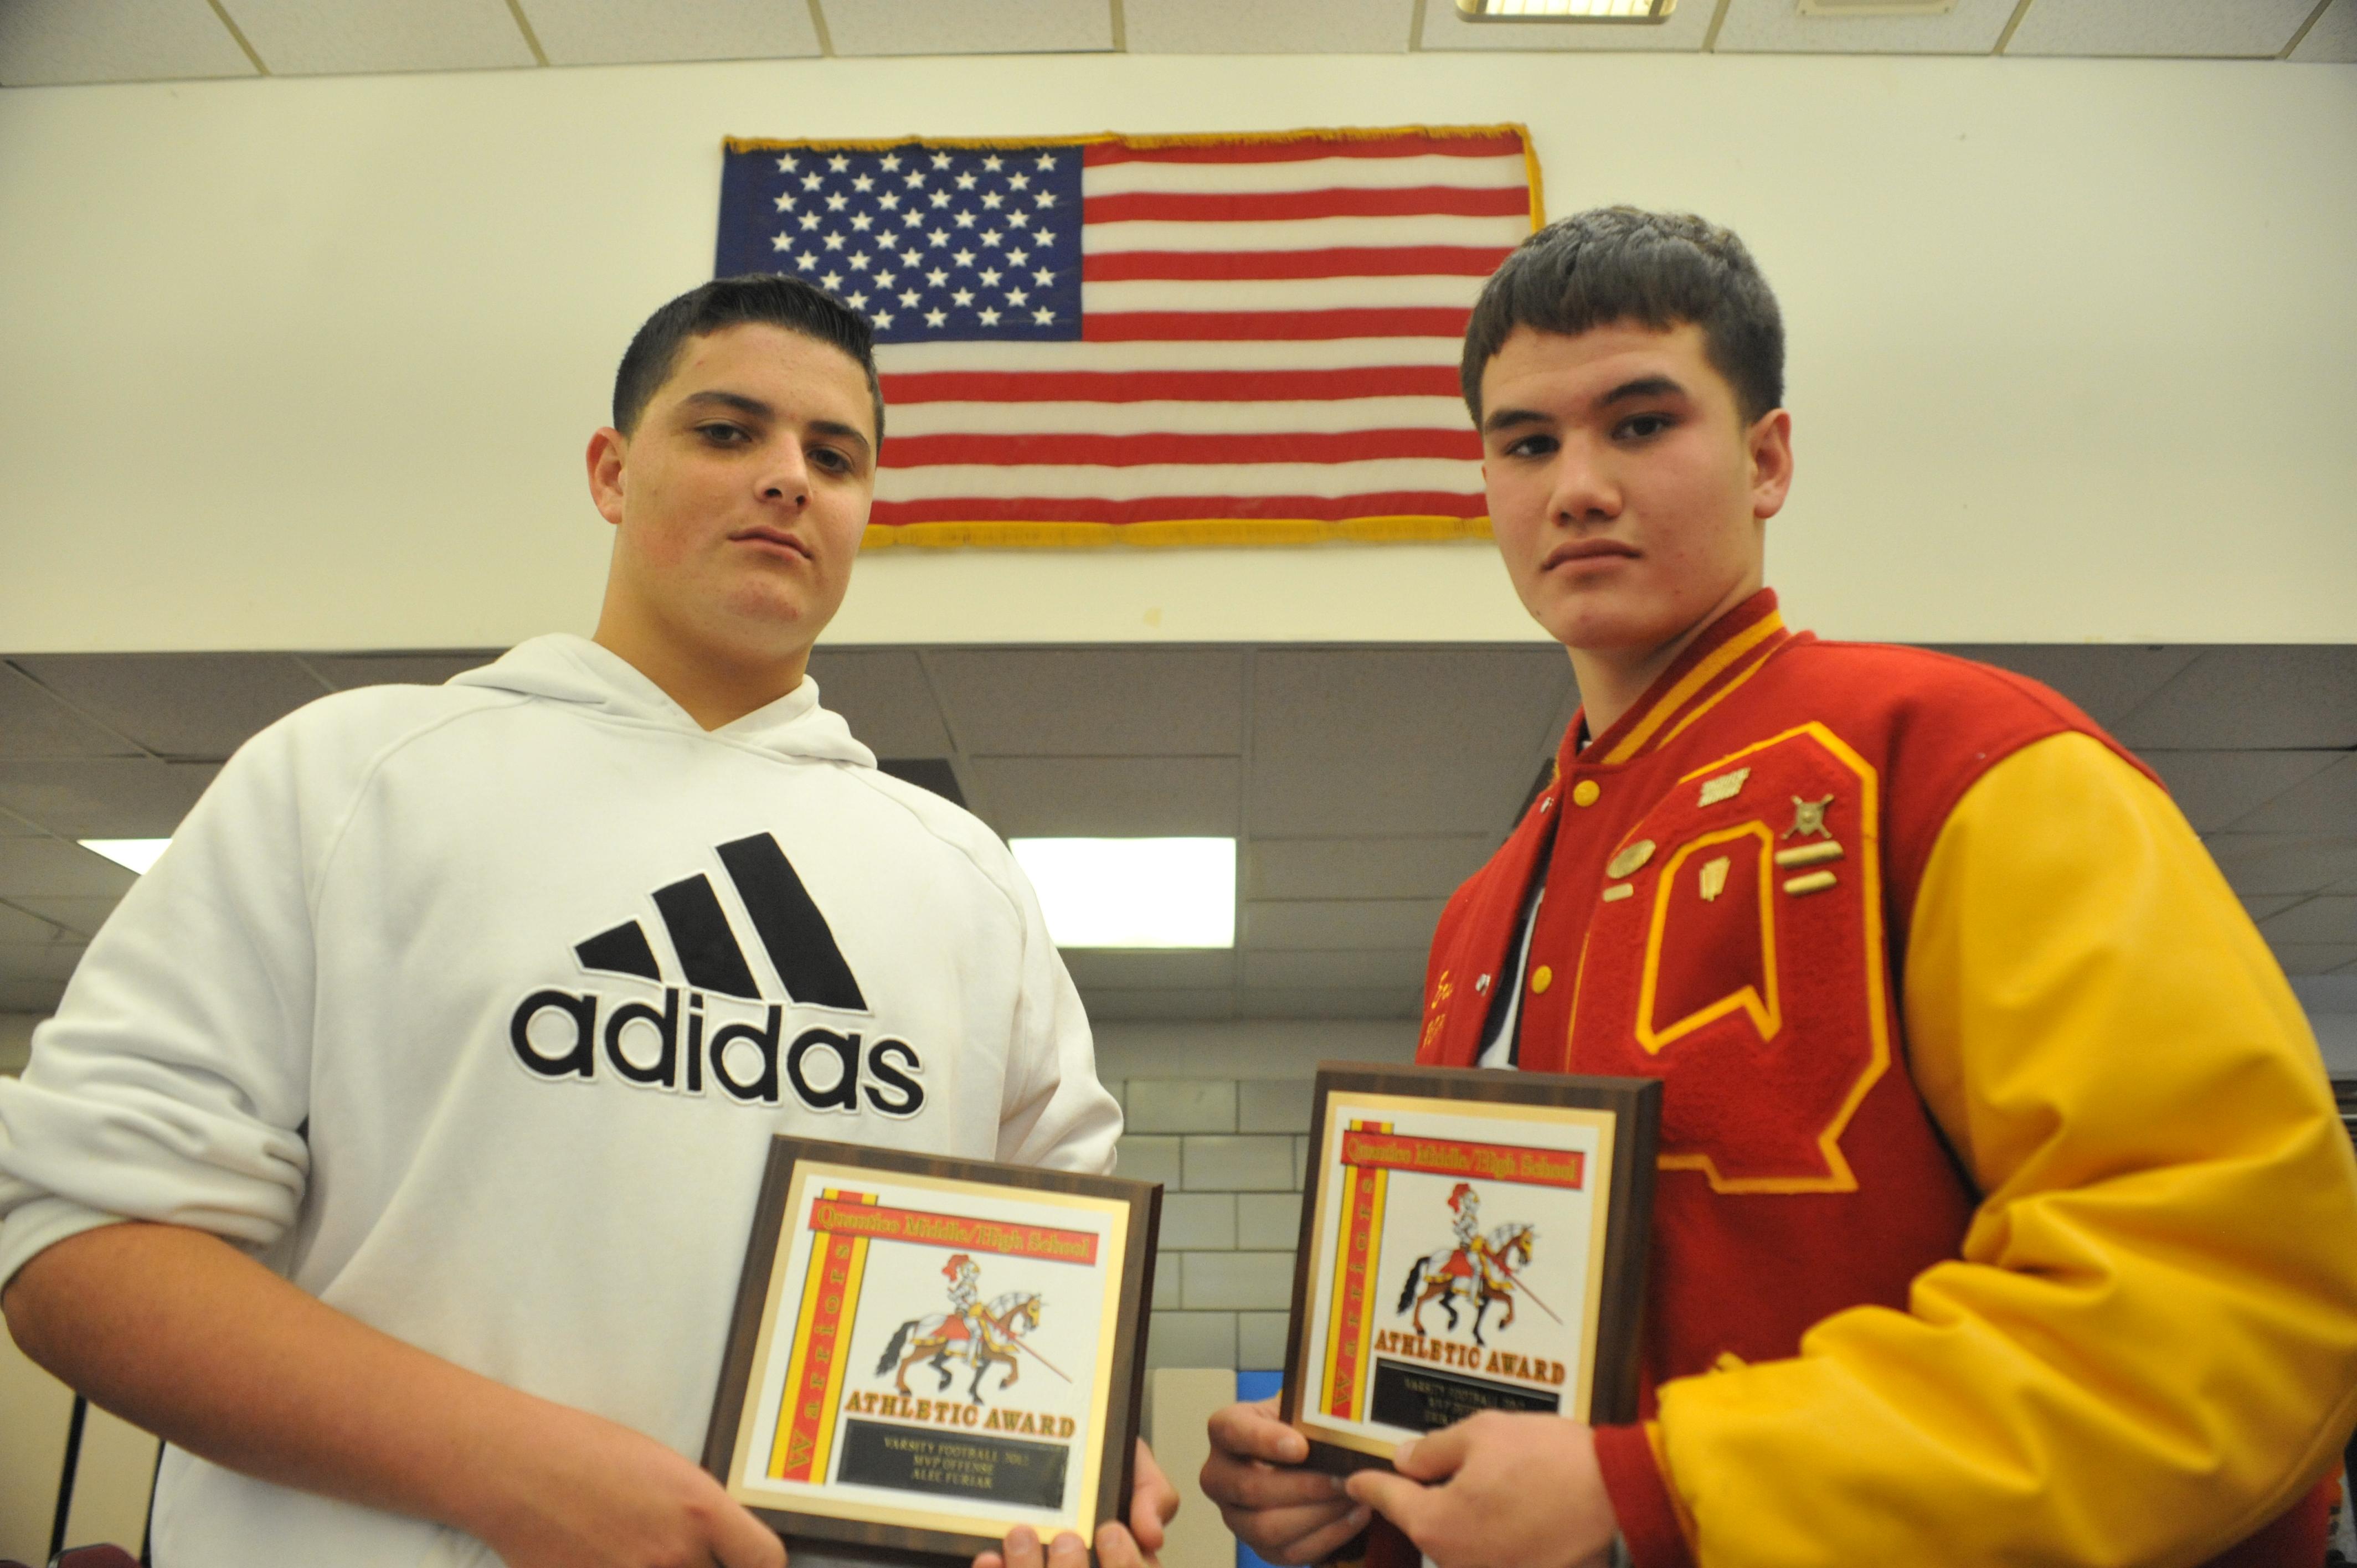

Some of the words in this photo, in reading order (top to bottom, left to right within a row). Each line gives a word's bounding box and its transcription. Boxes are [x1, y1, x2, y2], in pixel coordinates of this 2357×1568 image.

[511, 986, 925, 1115] adidas
[1520, 1153, 1578, 1182] School
[817, 1205, 900, 1232] Quantico
[904, 1216, 1023, 1252] Middle/High
[1027, 1231, 1090, 1258] School
[788, 1244, 851, 1470] Warriors
[1374, 1329, 1481, 1369] ATHLETIC
[1485, 1349, 1566, 1385] AWARD
[844, 1390, 979, 1426] ATHLETIC
[984, 1408, 1075, 1438] AWARD
[884, 1437, 935, 1453] VARSITY
